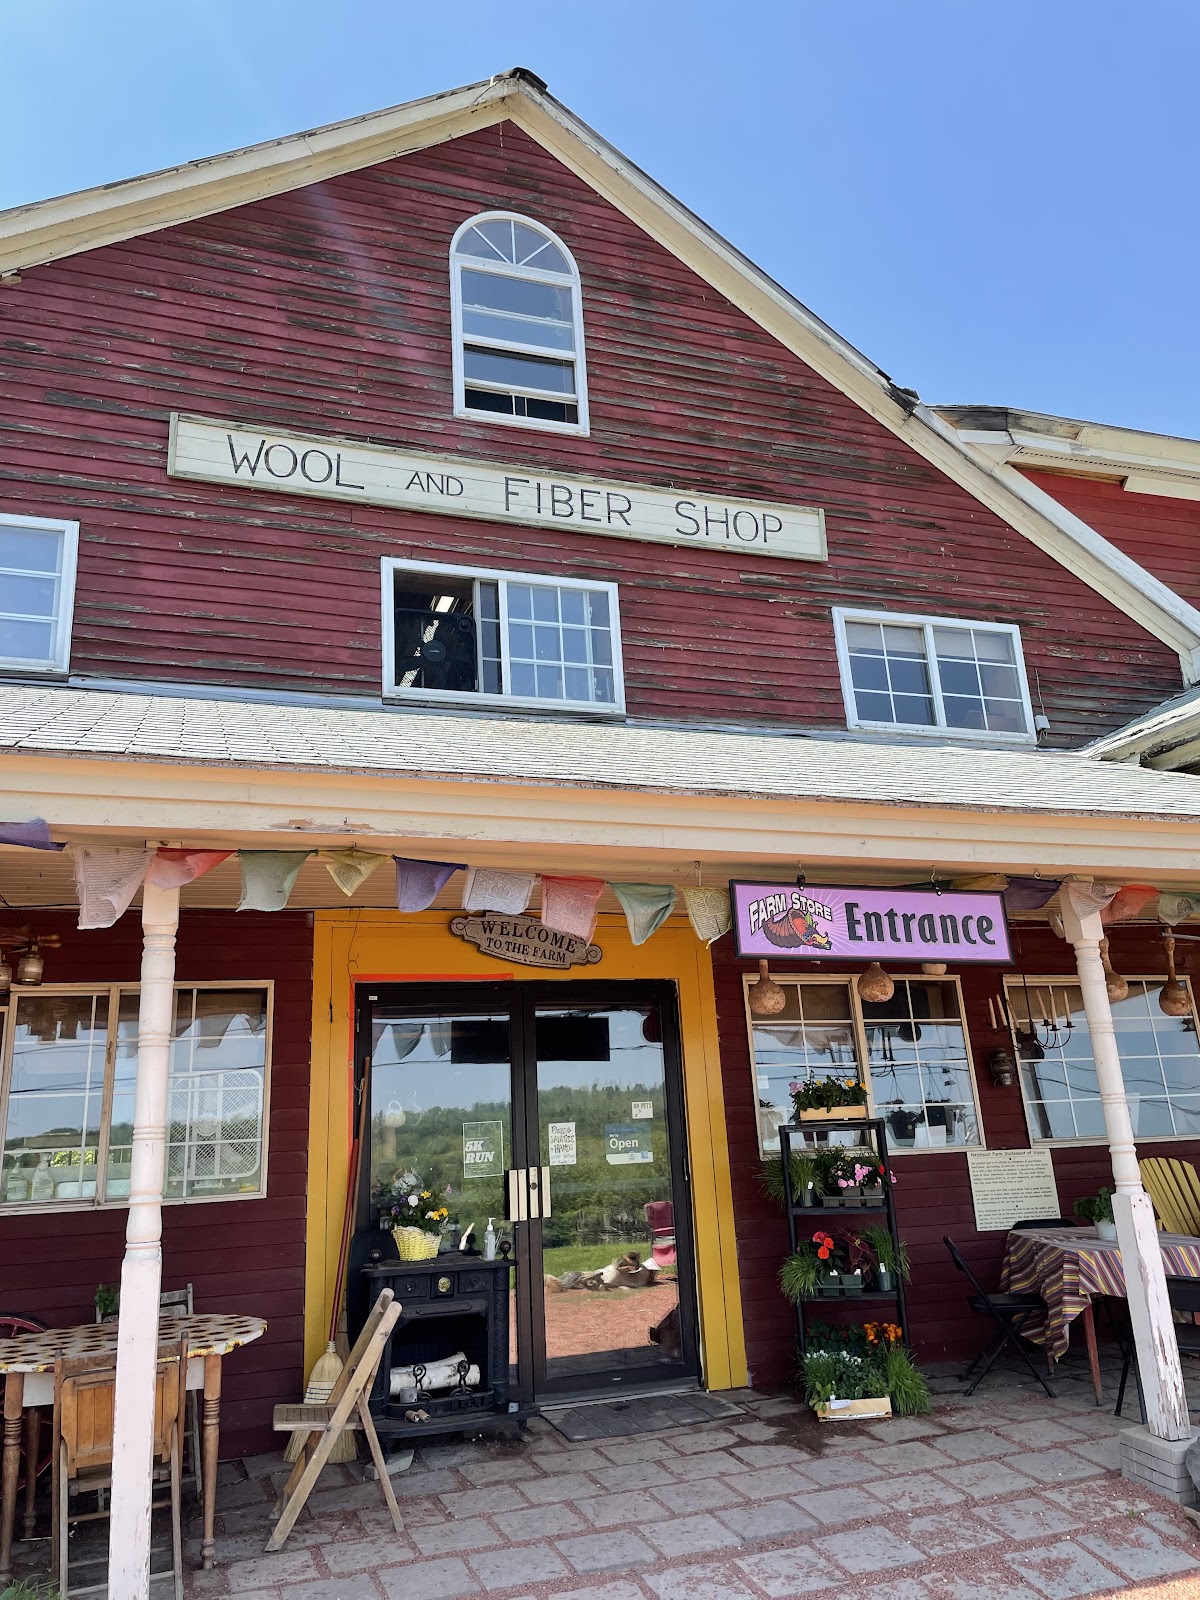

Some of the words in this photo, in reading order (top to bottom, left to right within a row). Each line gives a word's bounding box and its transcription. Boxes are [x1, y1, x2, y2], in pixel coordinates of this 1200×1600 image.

[226, 434, 365, 490] WOOL
[405, 470, 464, 497] AND
[504, 475, 632, 527] FIBER
[674, 500, 783, 543] SHOP
[748, 893, 788, 937] FARM
[790, 892, 833, 921] STORE
[844, 902, 996, 946] Entrance
[480, 920, 577, 954] WELCOME
[486, 937, 502, 949] TO
[504, 939, 530, 955] THE
[532, 946, 566, 963] FARM
[465, 1140, 484, 1152] 5K
[465, 1151, 495, 1164] RUN
[609, 1138, 638, 1151] Open
